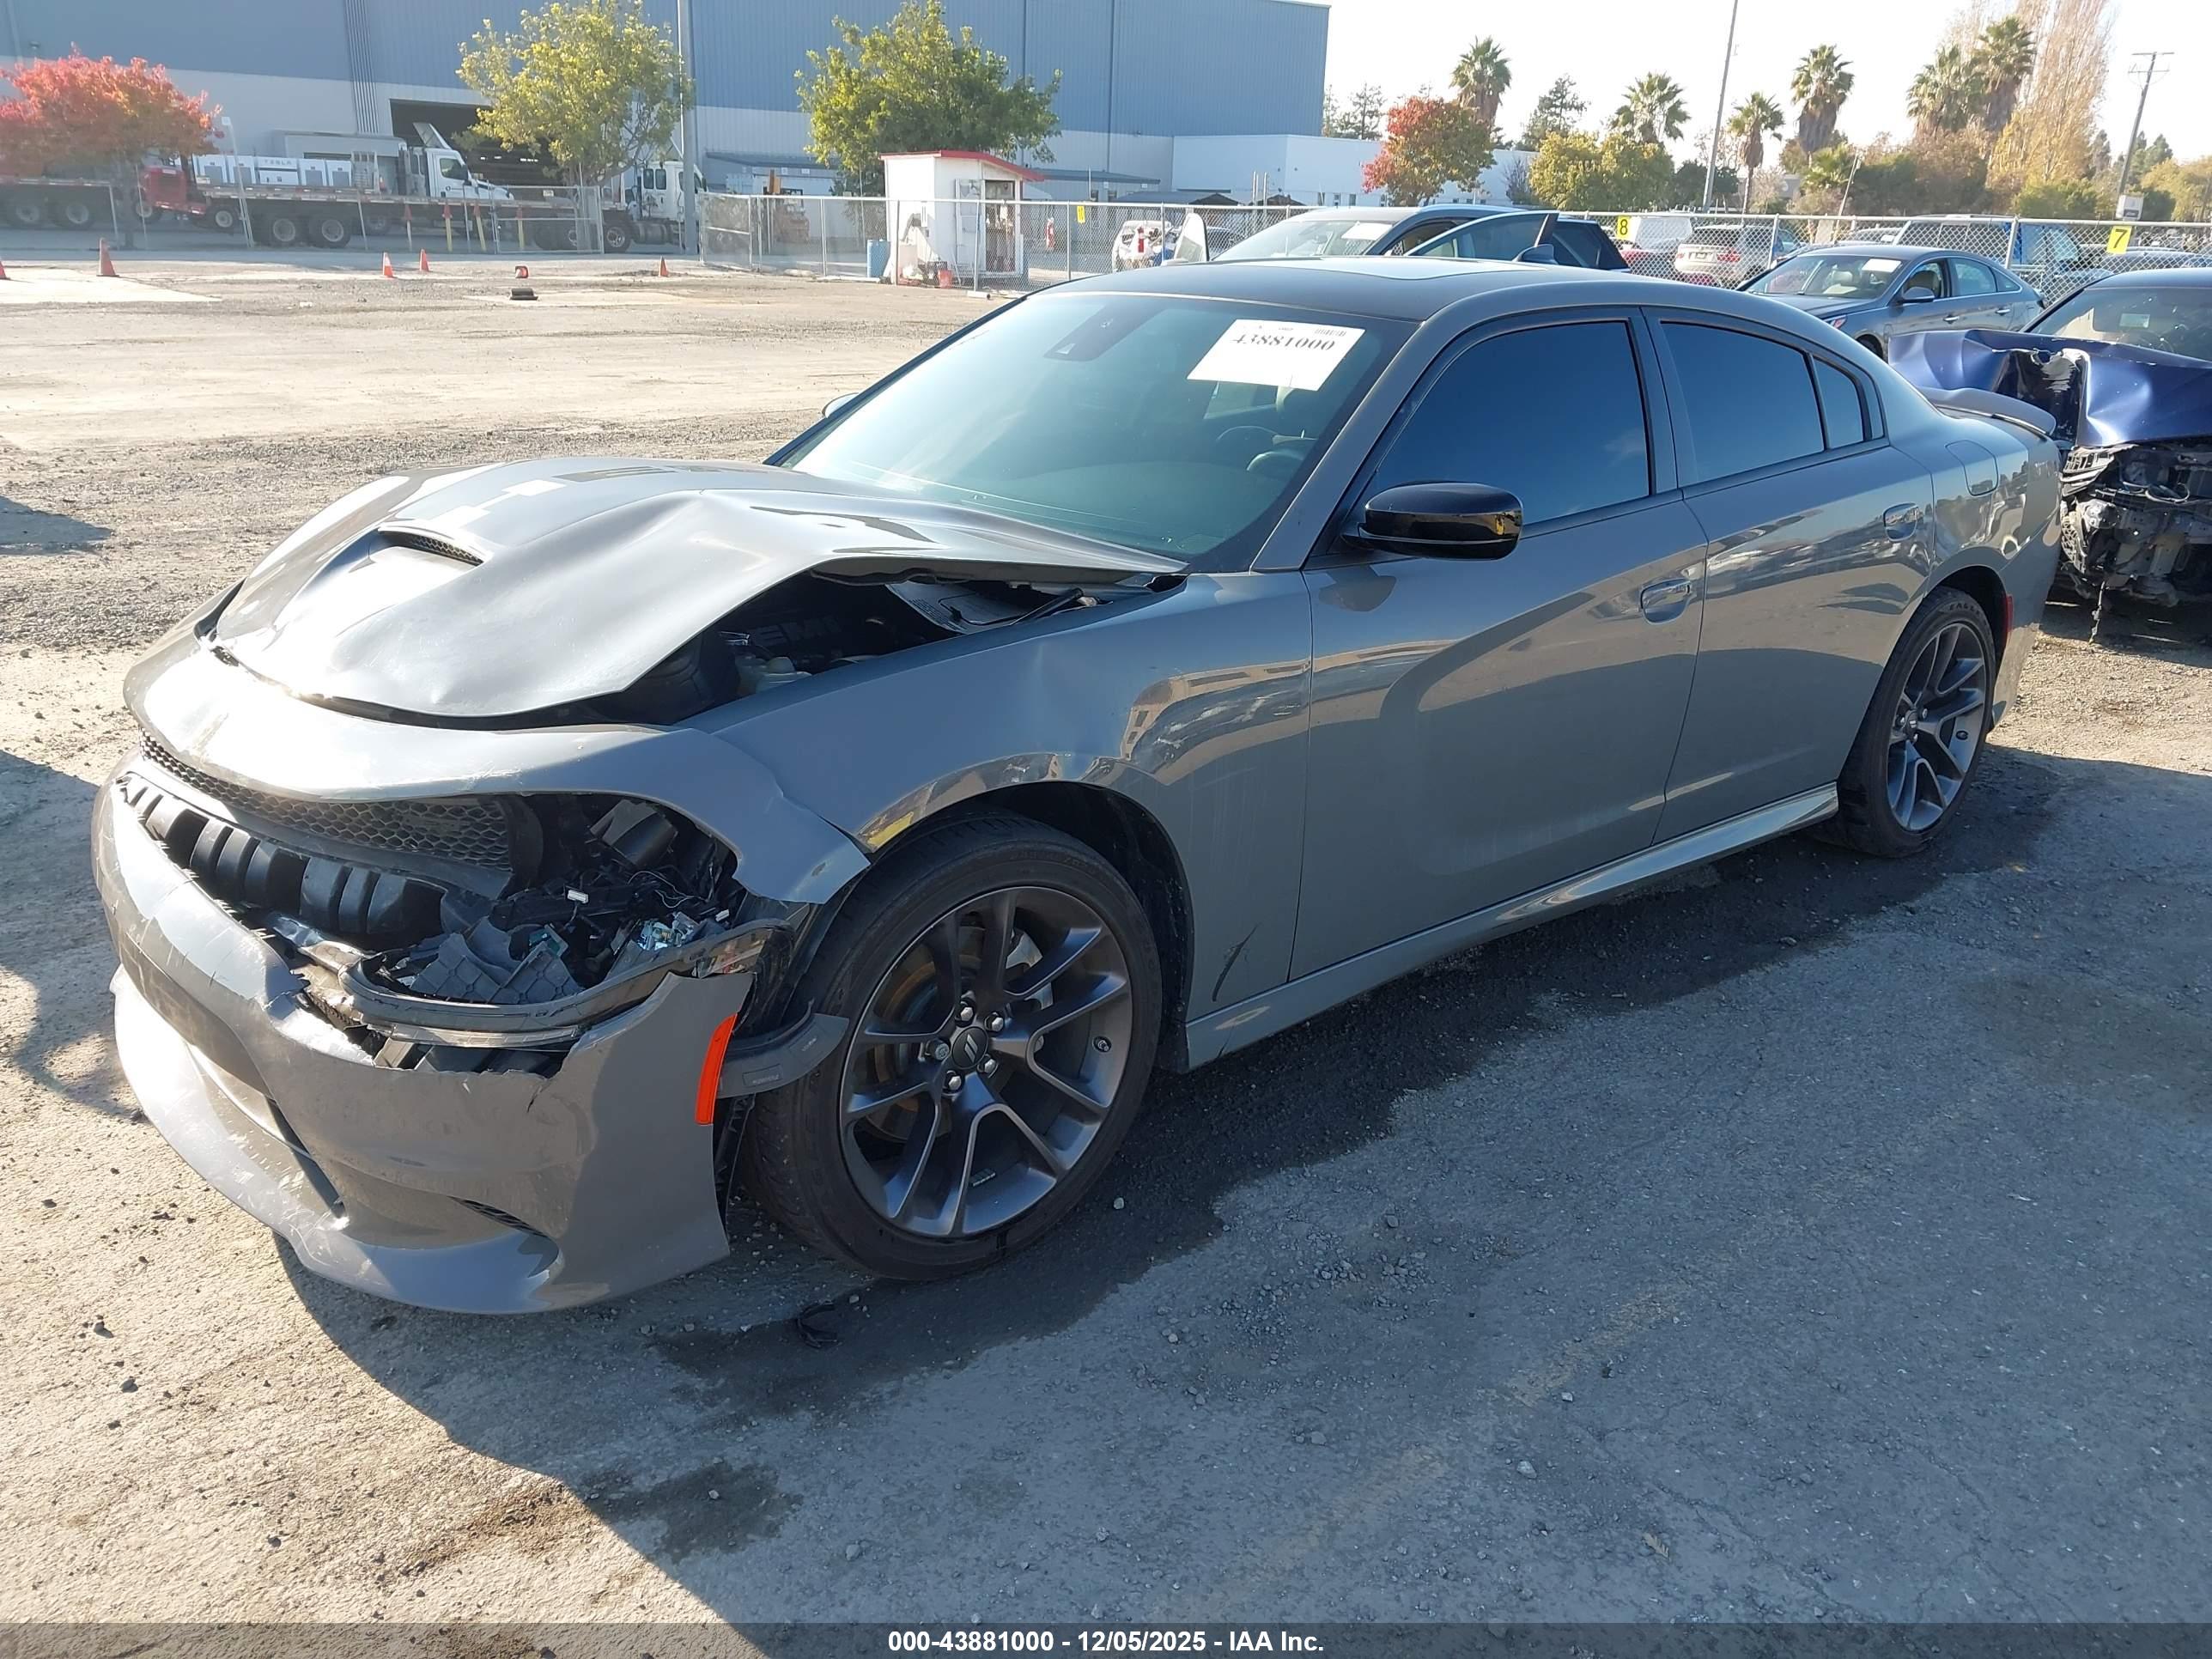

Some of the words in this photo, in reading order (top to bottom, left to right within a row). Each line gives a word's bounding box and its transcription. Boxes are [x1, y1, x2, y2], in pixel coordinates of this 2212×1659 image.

[1620, 218, 1628, 234] 8
[2112, 229, 2128, 248] 7
[1231, 333, 1336, 351] 43881000
